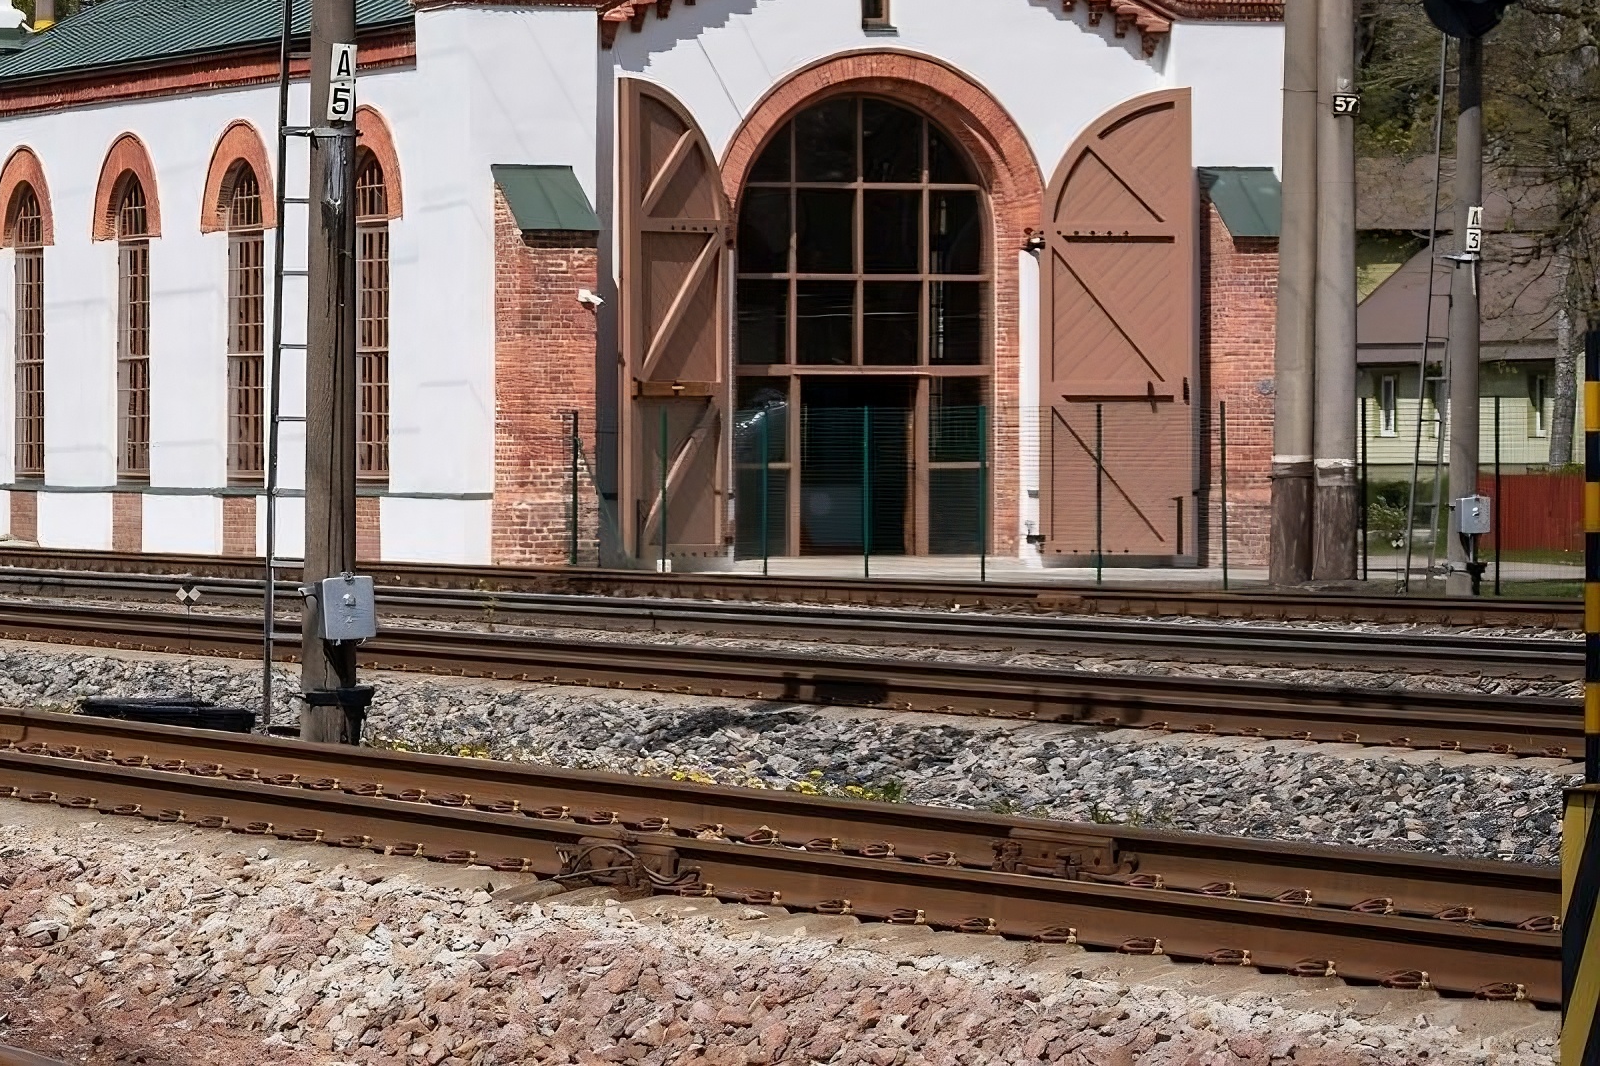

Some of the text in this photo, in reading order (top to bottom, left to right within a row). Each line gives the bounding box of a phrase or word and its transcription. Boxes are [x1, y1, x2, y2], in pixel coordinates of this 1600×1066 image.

[332, 49, 351, 115] A 5
[1335, 96, 1357, 112] 57
[1469, 232, 1479, 249] 3
